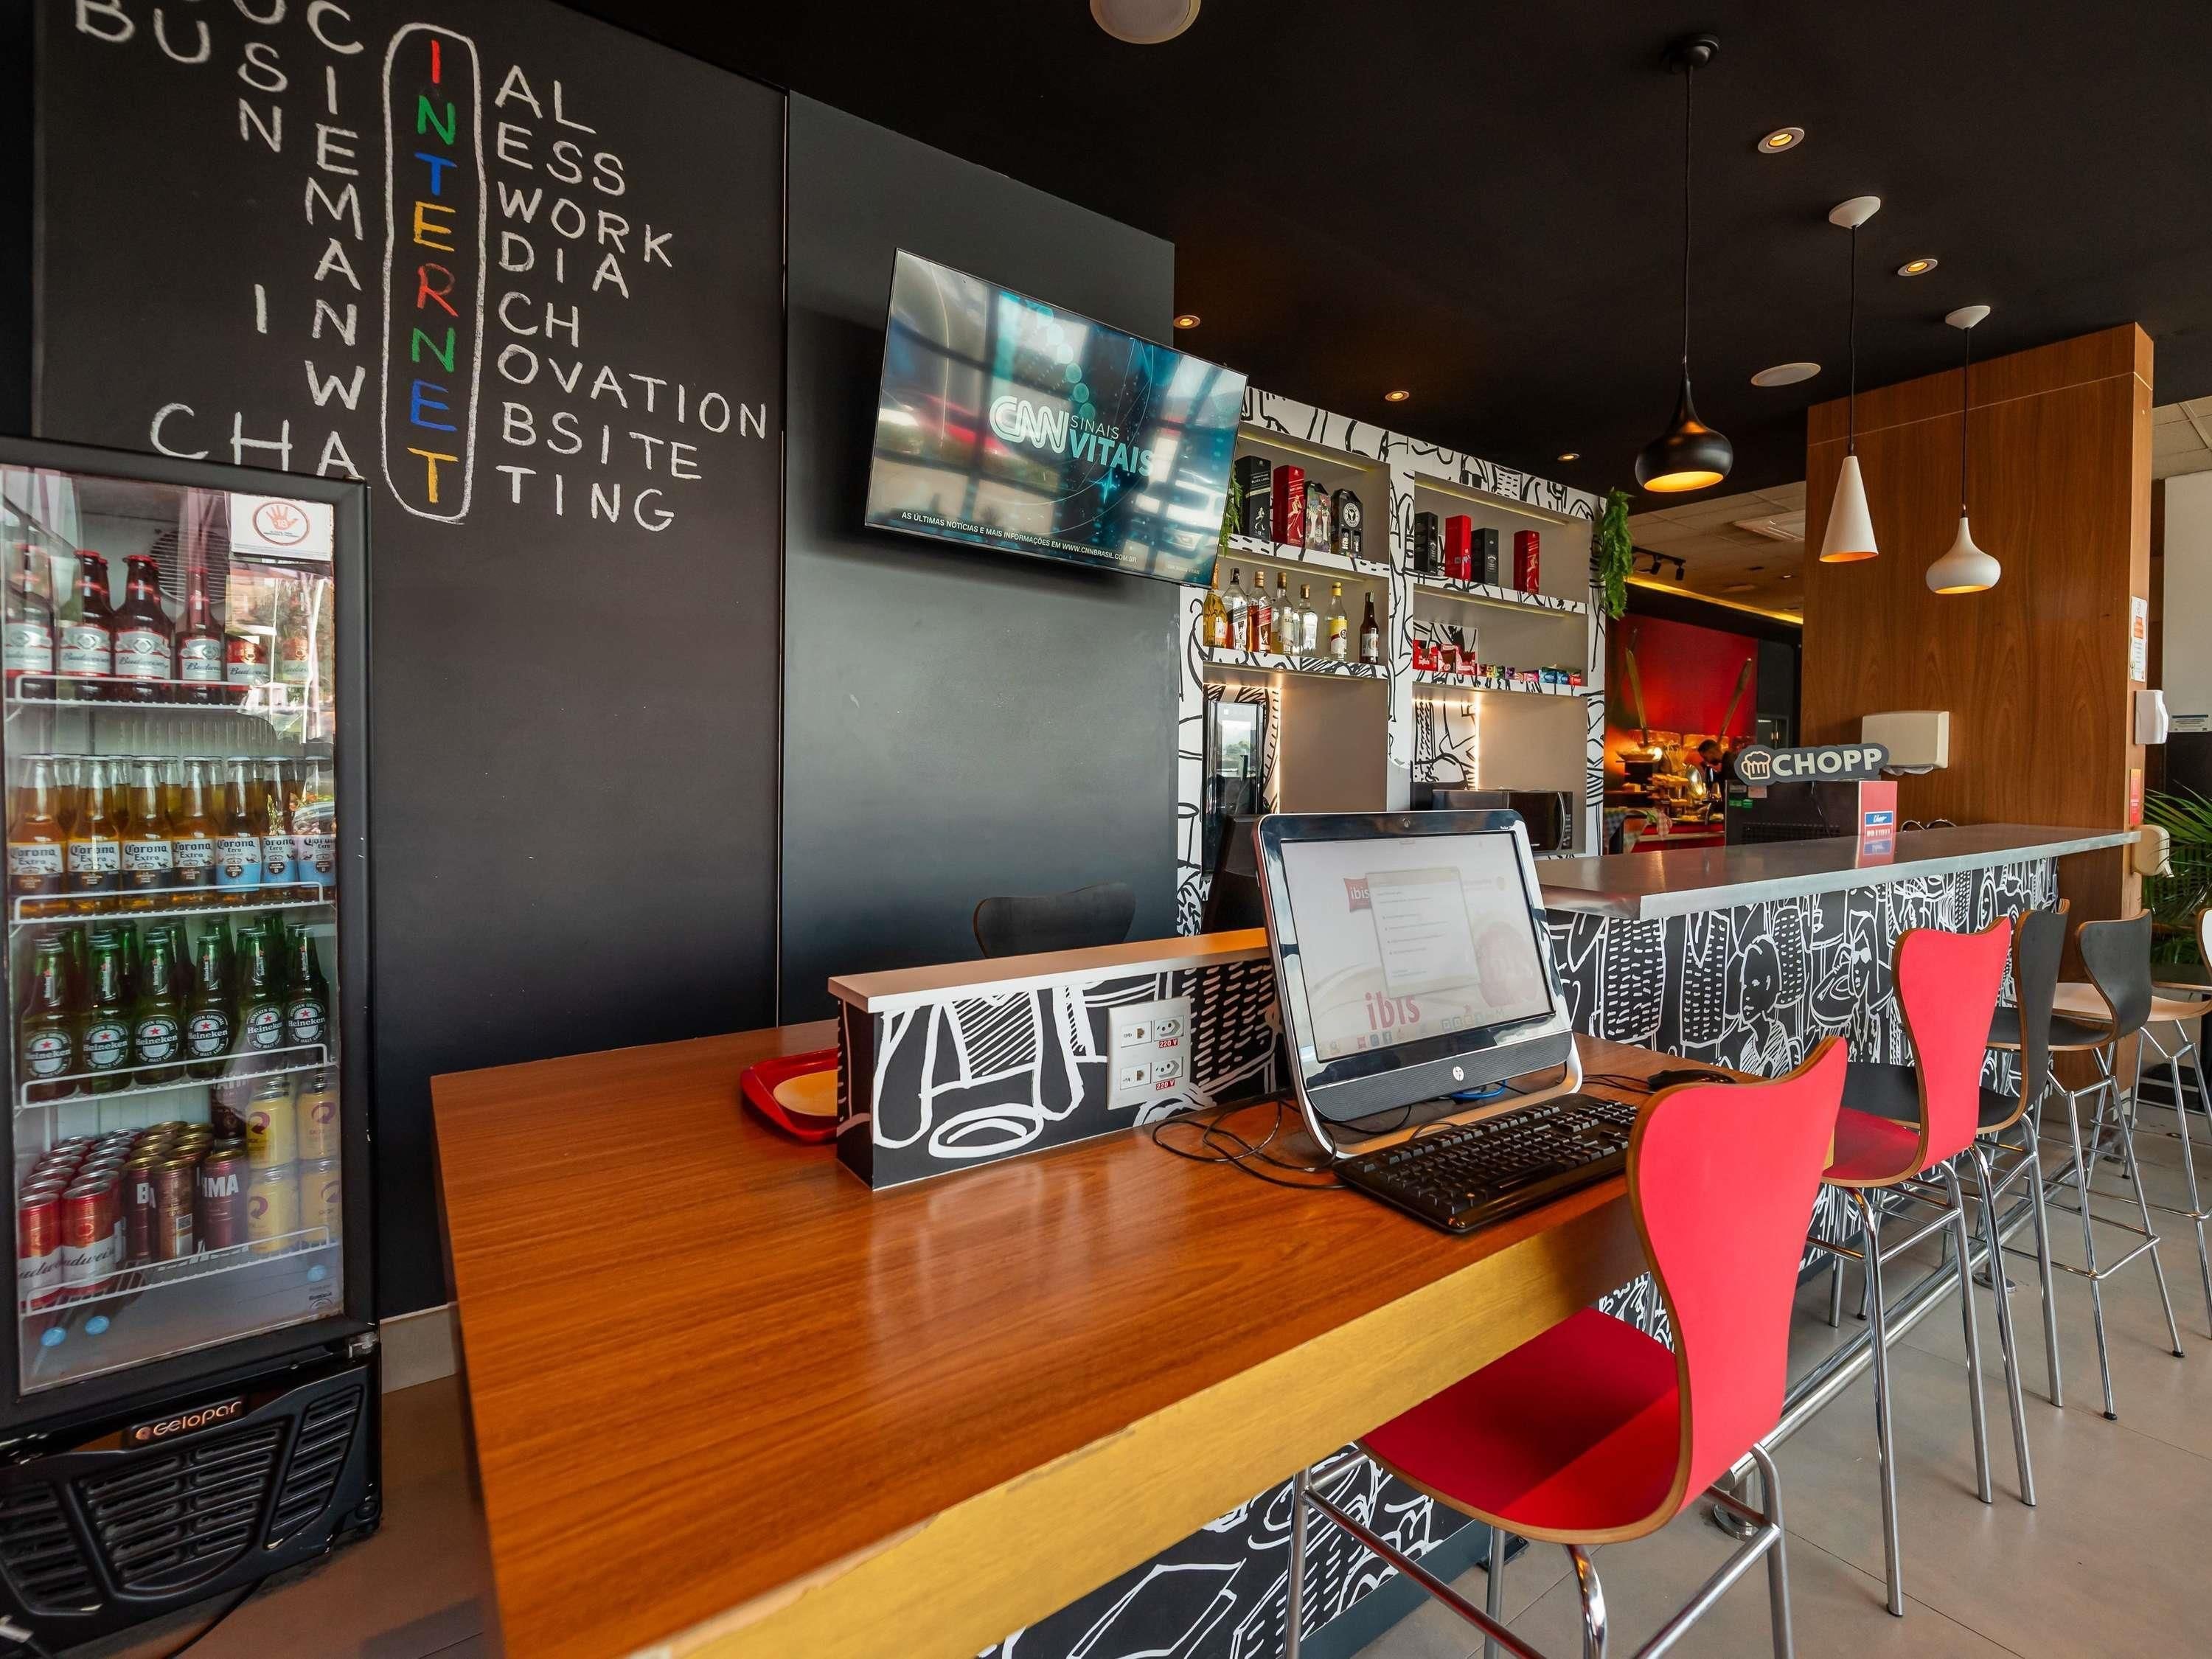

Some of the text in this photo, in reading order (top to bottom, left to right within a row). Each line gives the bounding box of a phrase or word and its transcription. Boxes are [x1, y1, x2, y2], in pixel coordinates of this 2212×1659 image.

[990, 395, 1069, 453] CNN
[1070, 415, 1120, 439] SINAIS
[1070, 429, 1155, 476] VITAIS
[901, 512, 913, 520] AS
[914, 513, 945, 526] ÚLTIMAS
[986, 527, 1003, 538] MAIS
[1051, 540, 1062, 549] EM
[1772, 748, 1882, 776] CHOPP
[125, 844, 167, 855] Corona
[217, 839, 255, 849] Corona
[134, 853, 159, 861] Extra
[180, 851, 204, 859] Extra
[1350, 886, 1369, 900] ibis
[1365, 990, 1421, 1031] ibis
[288, 1017, 325, 1027] Heineken
[1156, 1082, 1169, 1090] 220
